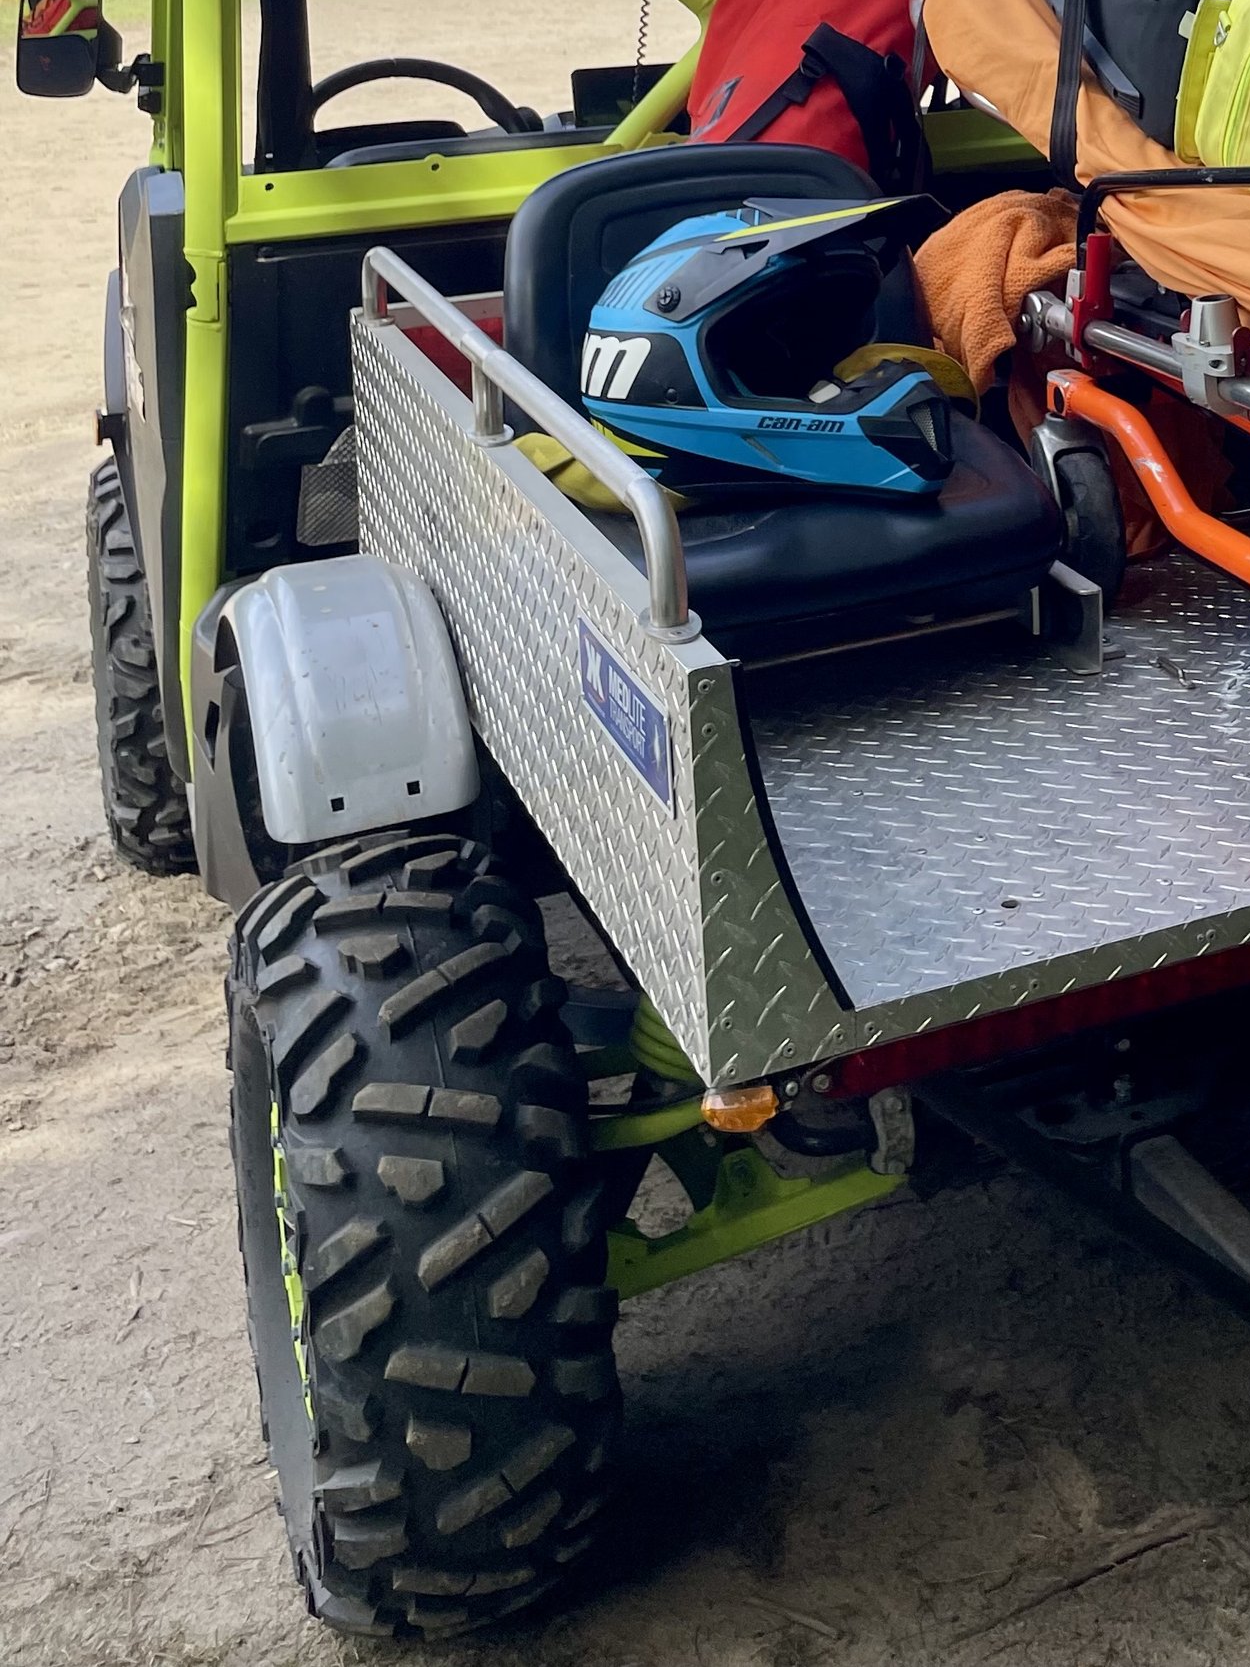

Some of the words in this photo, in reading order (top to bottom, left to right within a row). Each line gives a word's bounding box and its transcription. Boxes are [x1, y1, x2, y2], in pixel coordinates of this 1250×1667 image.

[581, 332, 652, 400] m
[757, 416, 845, 433] can-am
[608, 664, 647, 737] MEDLITE
[609, 696, 646, 760] TRANSPORT
